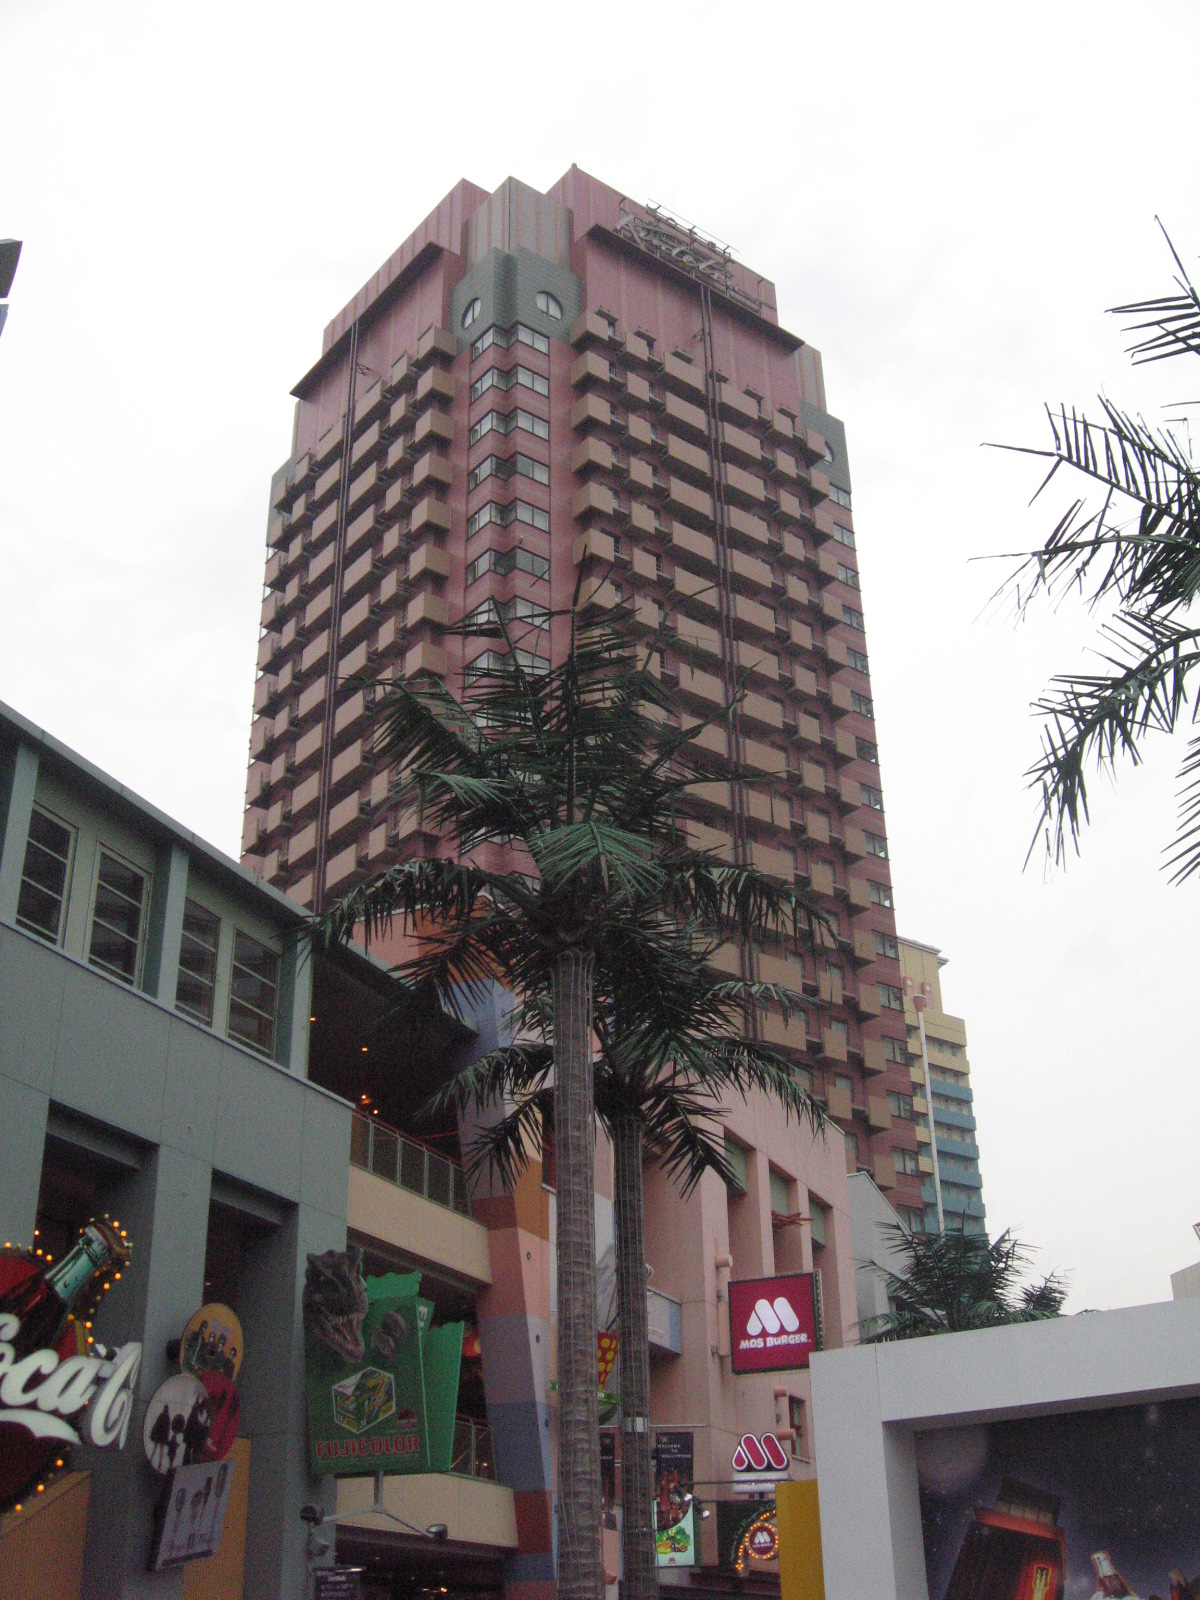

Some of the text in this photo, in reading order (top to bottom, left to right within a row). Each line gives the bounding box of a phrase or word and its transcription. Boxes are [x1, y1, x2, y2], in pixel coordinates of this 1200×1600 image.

[740, 1333, 808, 1349] MOS BURGER
[316, 1435, 420, 1458] FUJICOLOR
